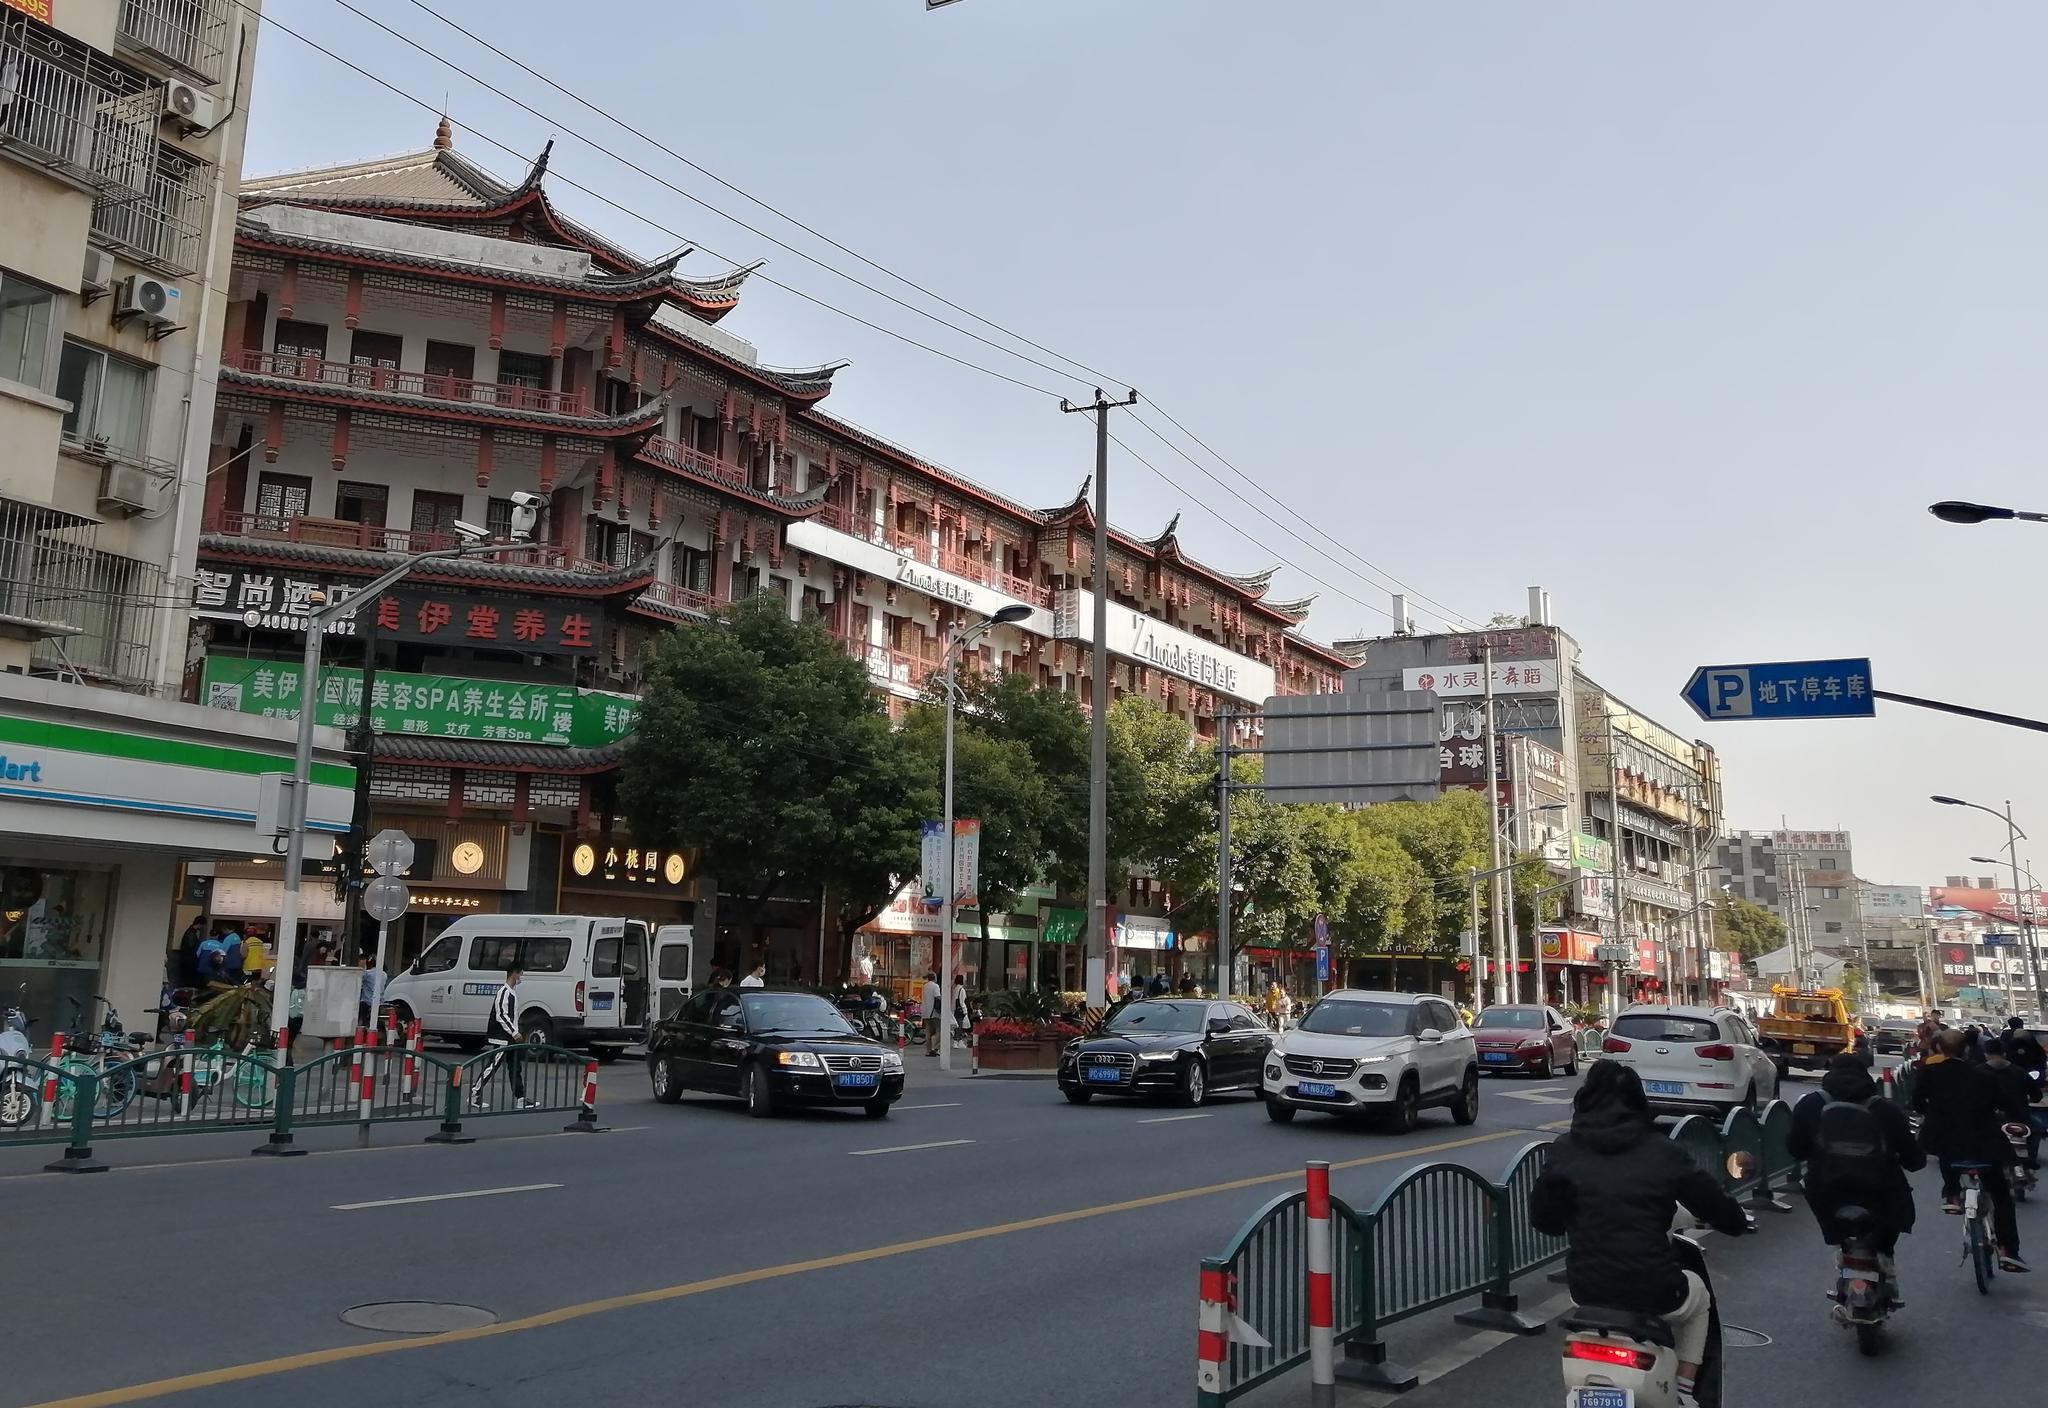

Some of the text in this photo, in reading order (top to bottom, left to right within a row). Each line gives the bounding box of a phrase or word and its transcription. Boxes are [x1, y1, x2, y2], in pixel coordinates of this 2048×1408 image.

[377, 595, 593, 648] 美伊堂养生
[252, 668, 549, 722] 美伊国际美容SPA养生会所
[1714, 674, 1867, 711] P 地下停车库
[402, 718, 429, 733] 塑形
[482, 725, 532, 740] 芳香Spa
[604, 847, 657, 871] 小桃园
